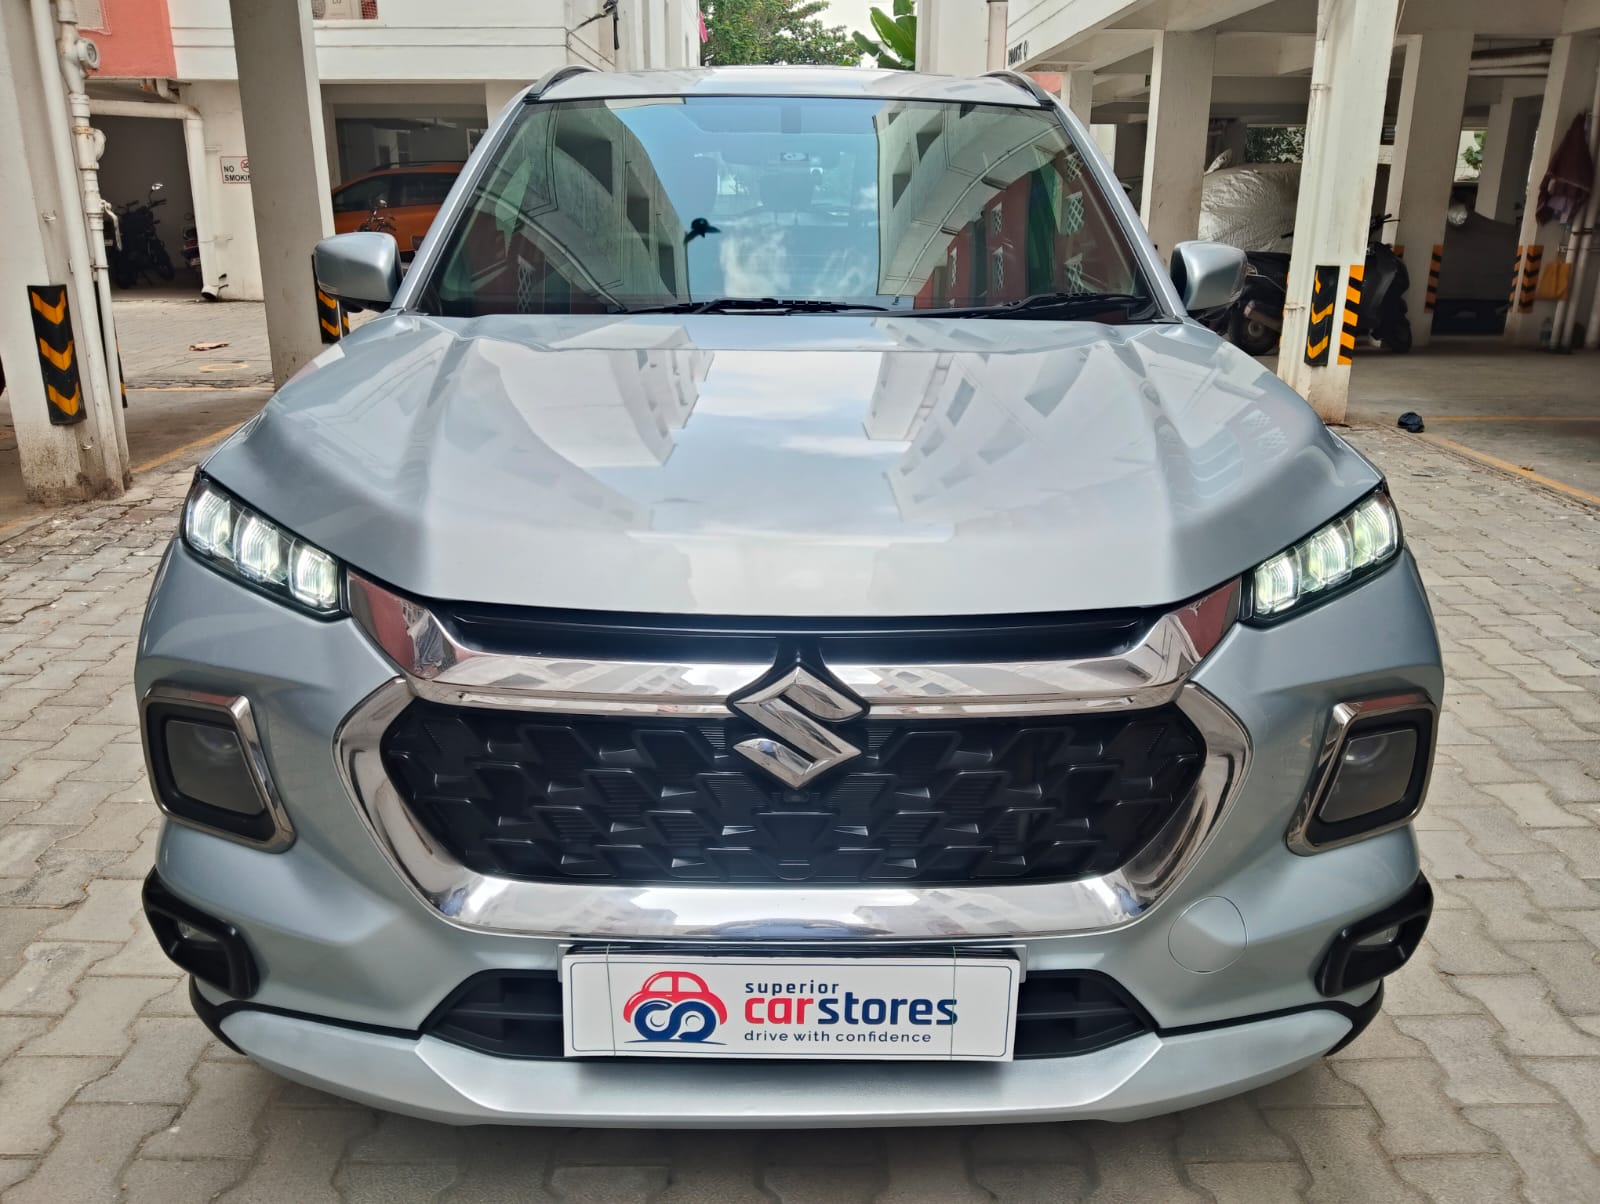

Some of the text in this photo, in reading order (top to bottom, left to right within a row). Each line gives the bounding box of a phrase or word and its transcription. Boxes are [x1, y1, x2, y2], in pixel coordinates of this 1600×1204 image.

[745, 980, 839, 996] superior
[745, 992, 958, 1025] carstores
[744, 1030, 932, 1043] drive with confidence
